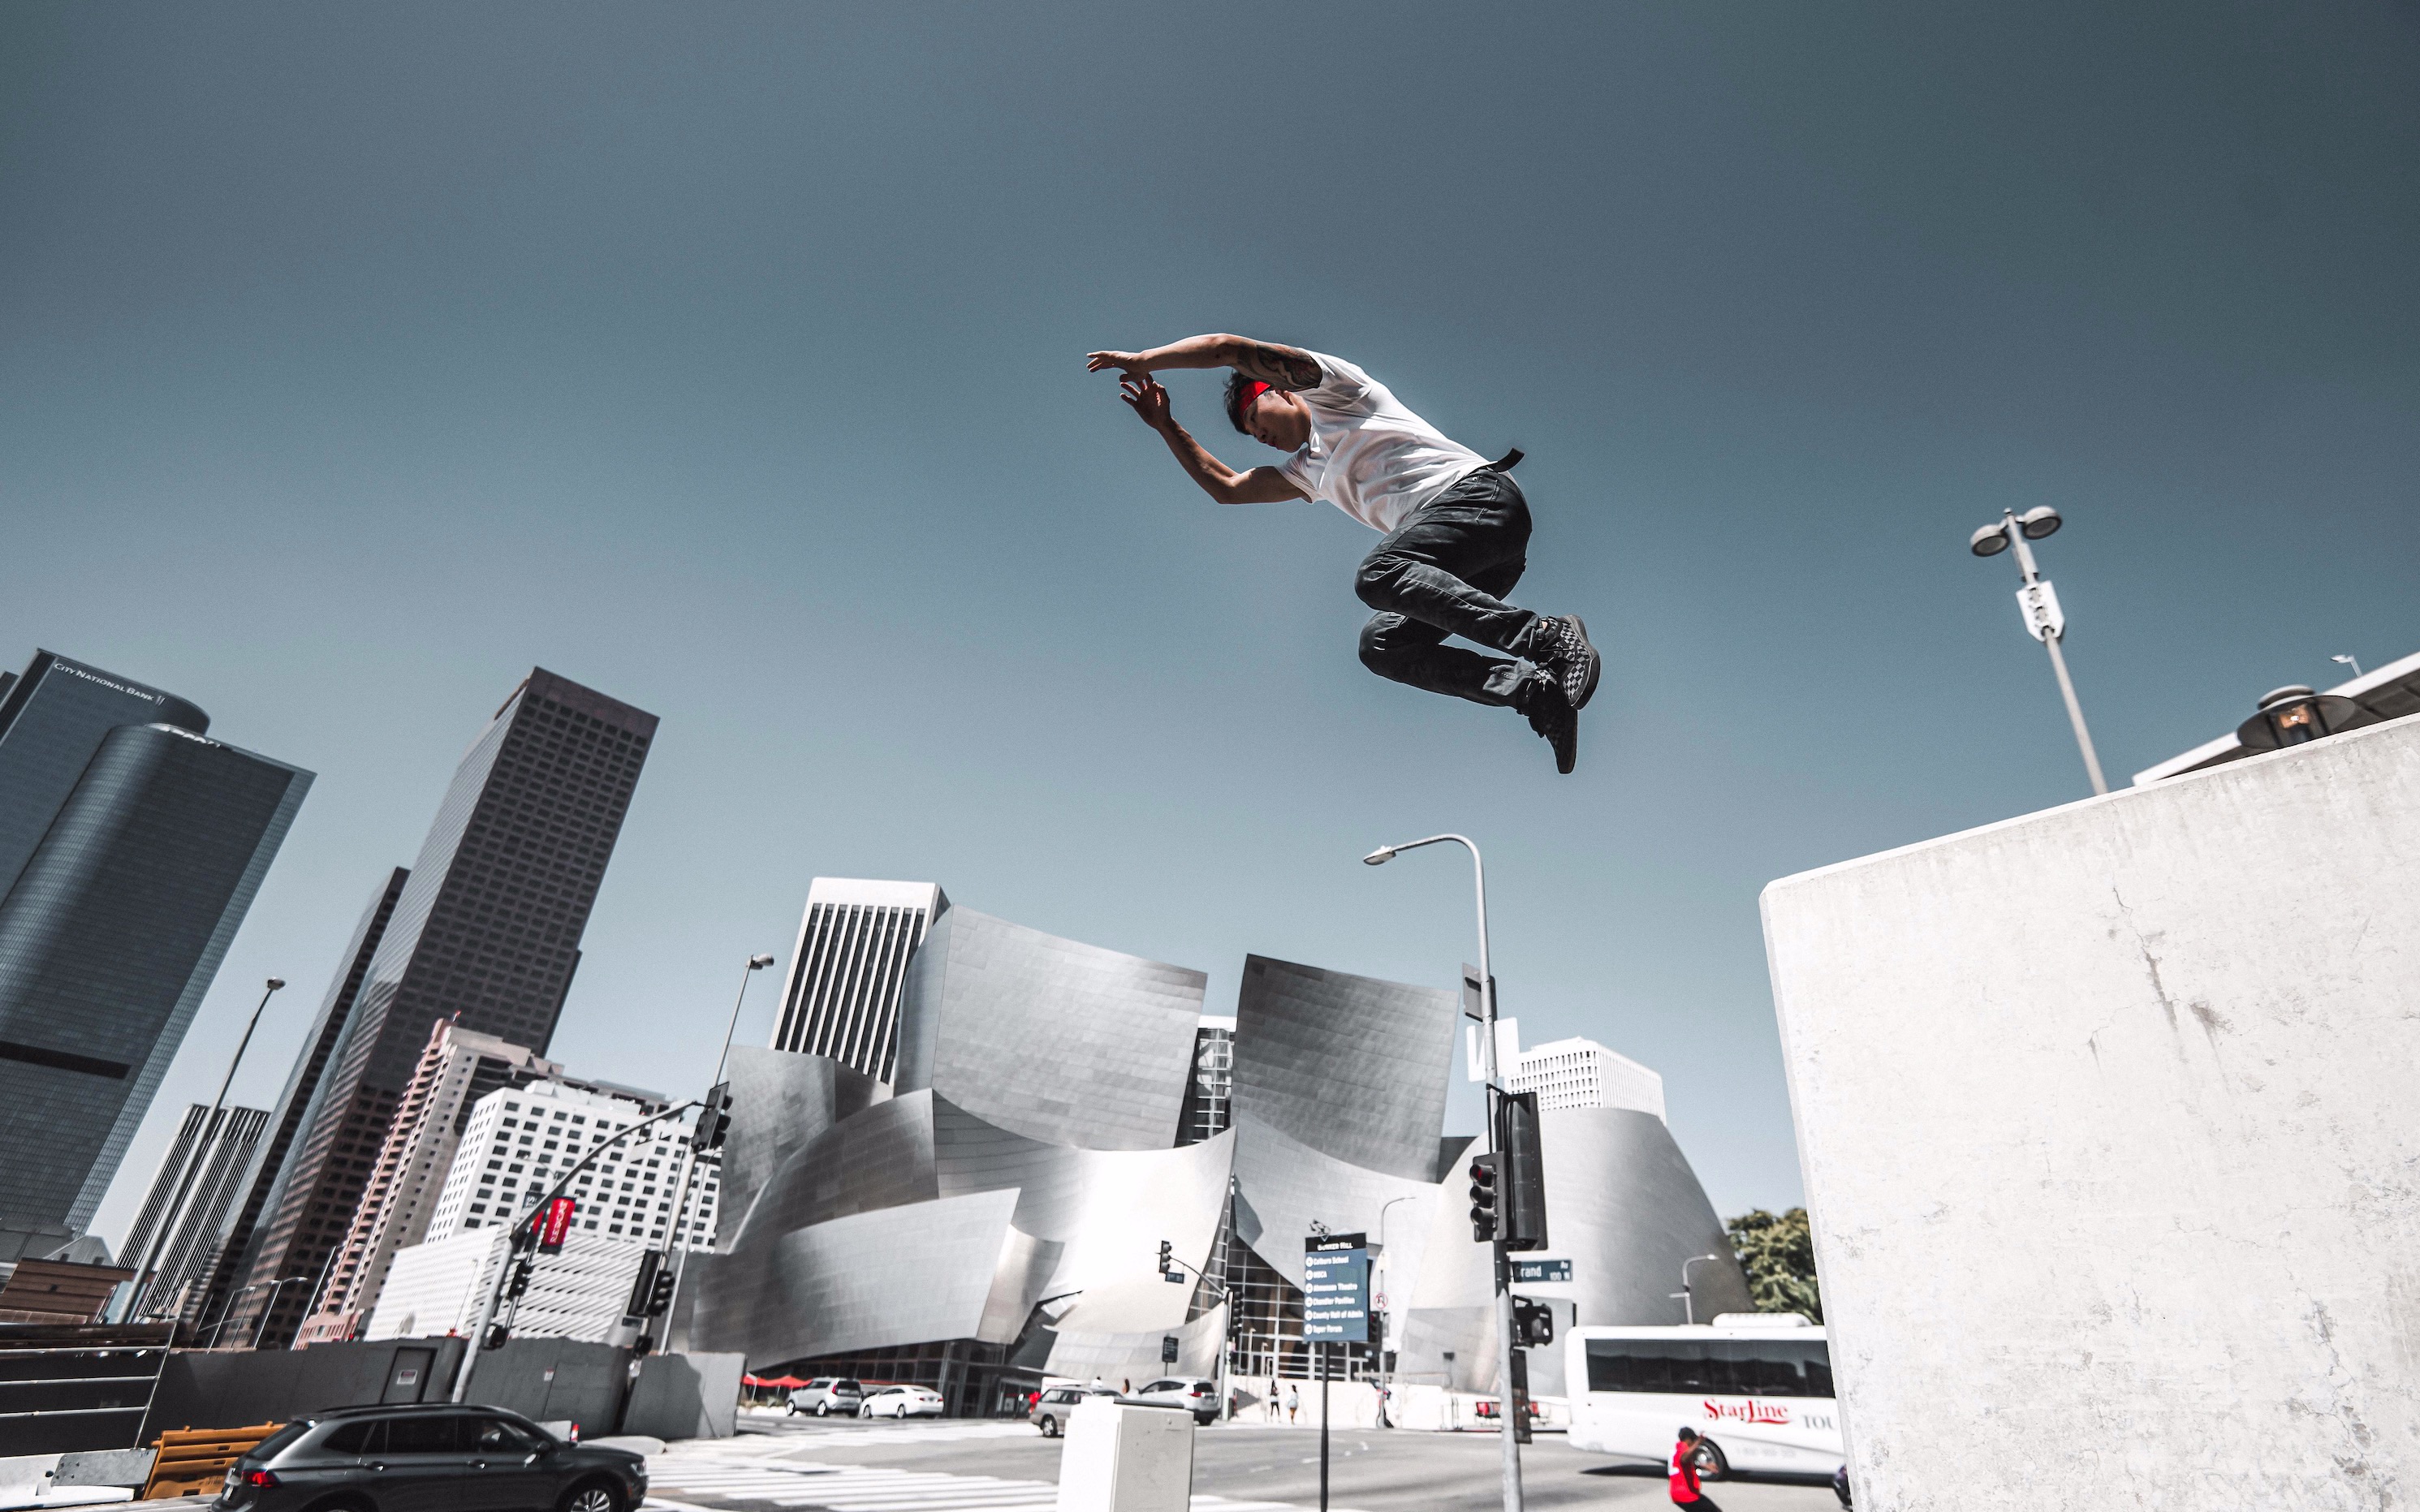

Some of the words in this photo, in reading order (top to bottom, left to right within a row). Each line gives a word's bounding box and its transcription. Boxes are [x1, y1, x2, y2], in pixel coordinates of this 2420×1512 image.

[54, 662, 76, 675] CITY
[75, 670, 126, 692] NATIONAL
[126, 687, 155, 701] BANK
[1331, 1256, 1349, 1264] School
